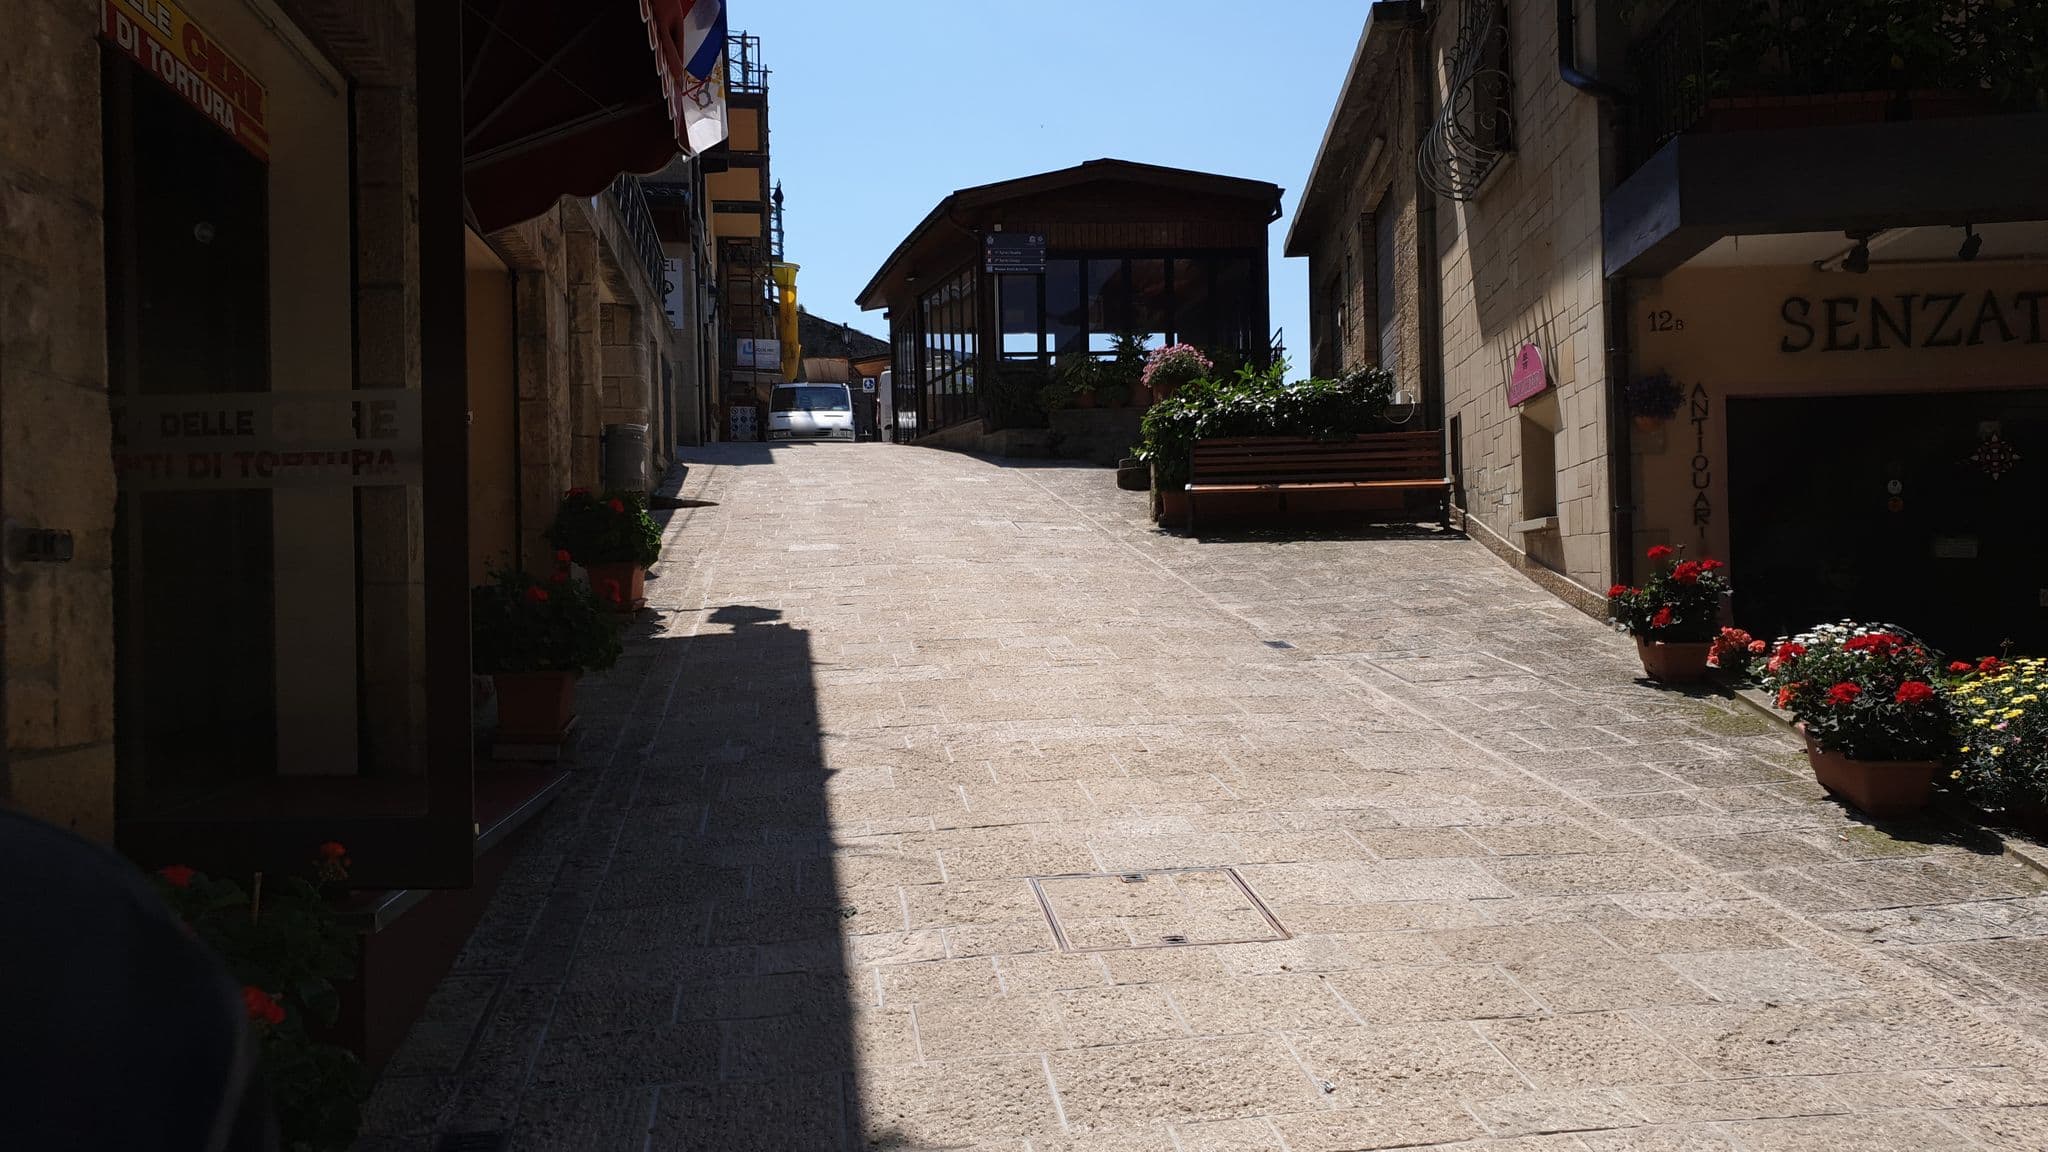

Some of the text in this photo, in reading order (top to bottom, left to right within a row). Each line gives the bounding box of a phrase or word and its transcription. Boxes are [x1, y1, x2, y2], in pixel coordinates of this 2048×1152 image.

[115, 11, 141, 58] DI
[146, 37, 237, 136] TORTURA
[1780, 288, 2048, 354] SENZAT
[159, 410, 256, 437] DELLE
[187, 452, 224, 479] DI
[1690, 382, 1711, 539] ANTIQUARI
